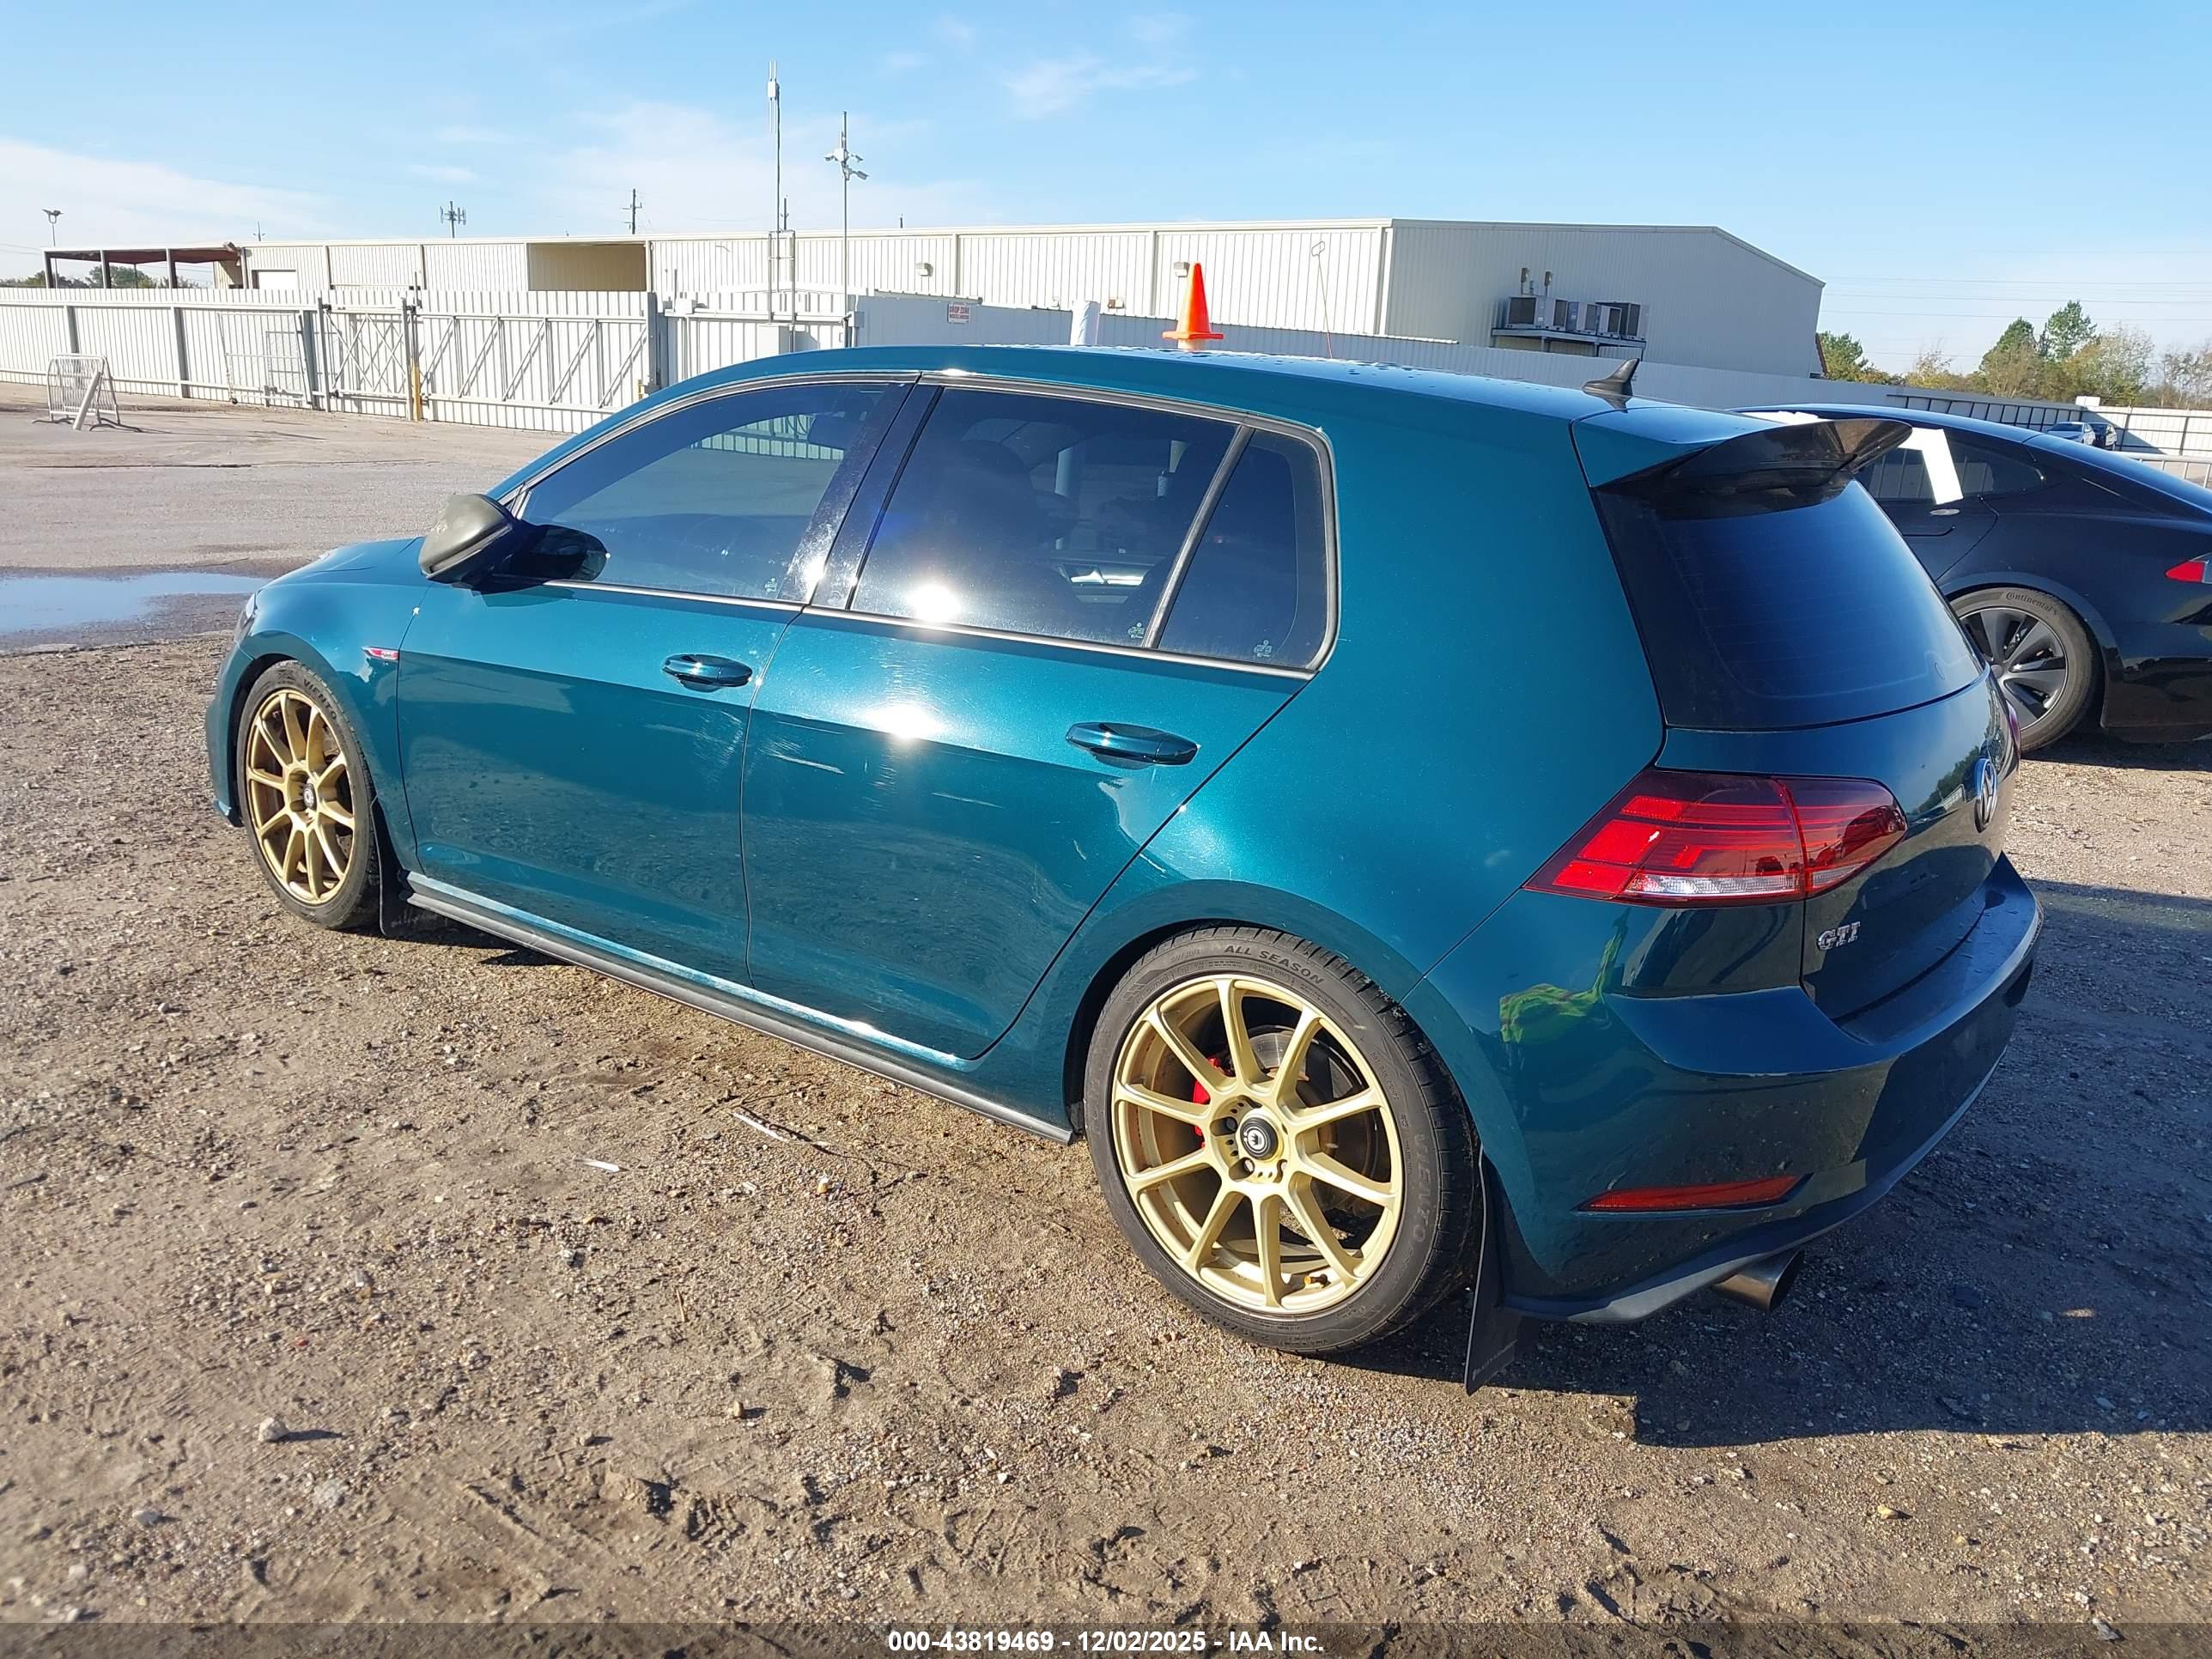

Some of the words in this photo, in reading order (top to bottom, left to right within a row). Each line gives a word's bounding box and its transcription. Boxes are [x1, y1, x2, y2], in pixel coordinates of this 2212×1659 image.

[303, 678, 337, 720] VIENTO
[1818, 921, 1861, 951] GTI
[1224, 945, 1253, 956] ALL
[1259, 951, 1325, 984] SEASON
